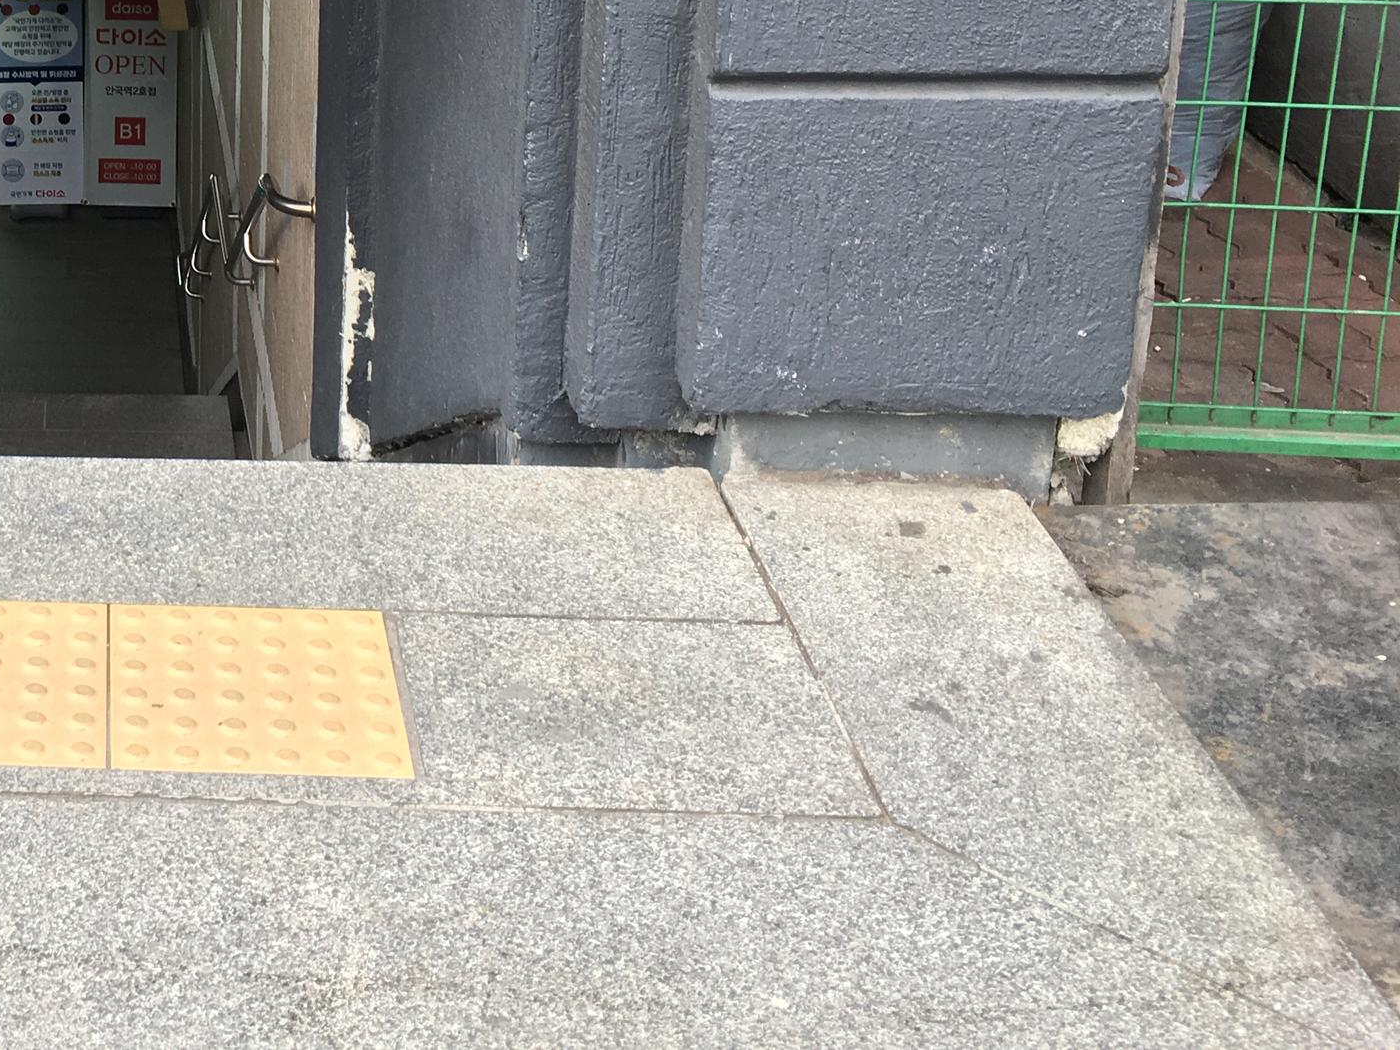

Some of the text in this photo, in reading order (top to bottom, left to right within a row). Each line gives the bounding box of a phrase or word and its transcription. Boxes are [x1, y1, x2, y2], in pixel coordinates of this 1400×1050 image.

[111, 2, 153, 15] daiso
[95, 27, 167, 47] 다이소
[95, 55, 166, 75] OPEN
[105, 85, 157, 97] 안국역2호점
[118, 123, 142, 140] B1
[35, 189, 66, 198] 다이소
